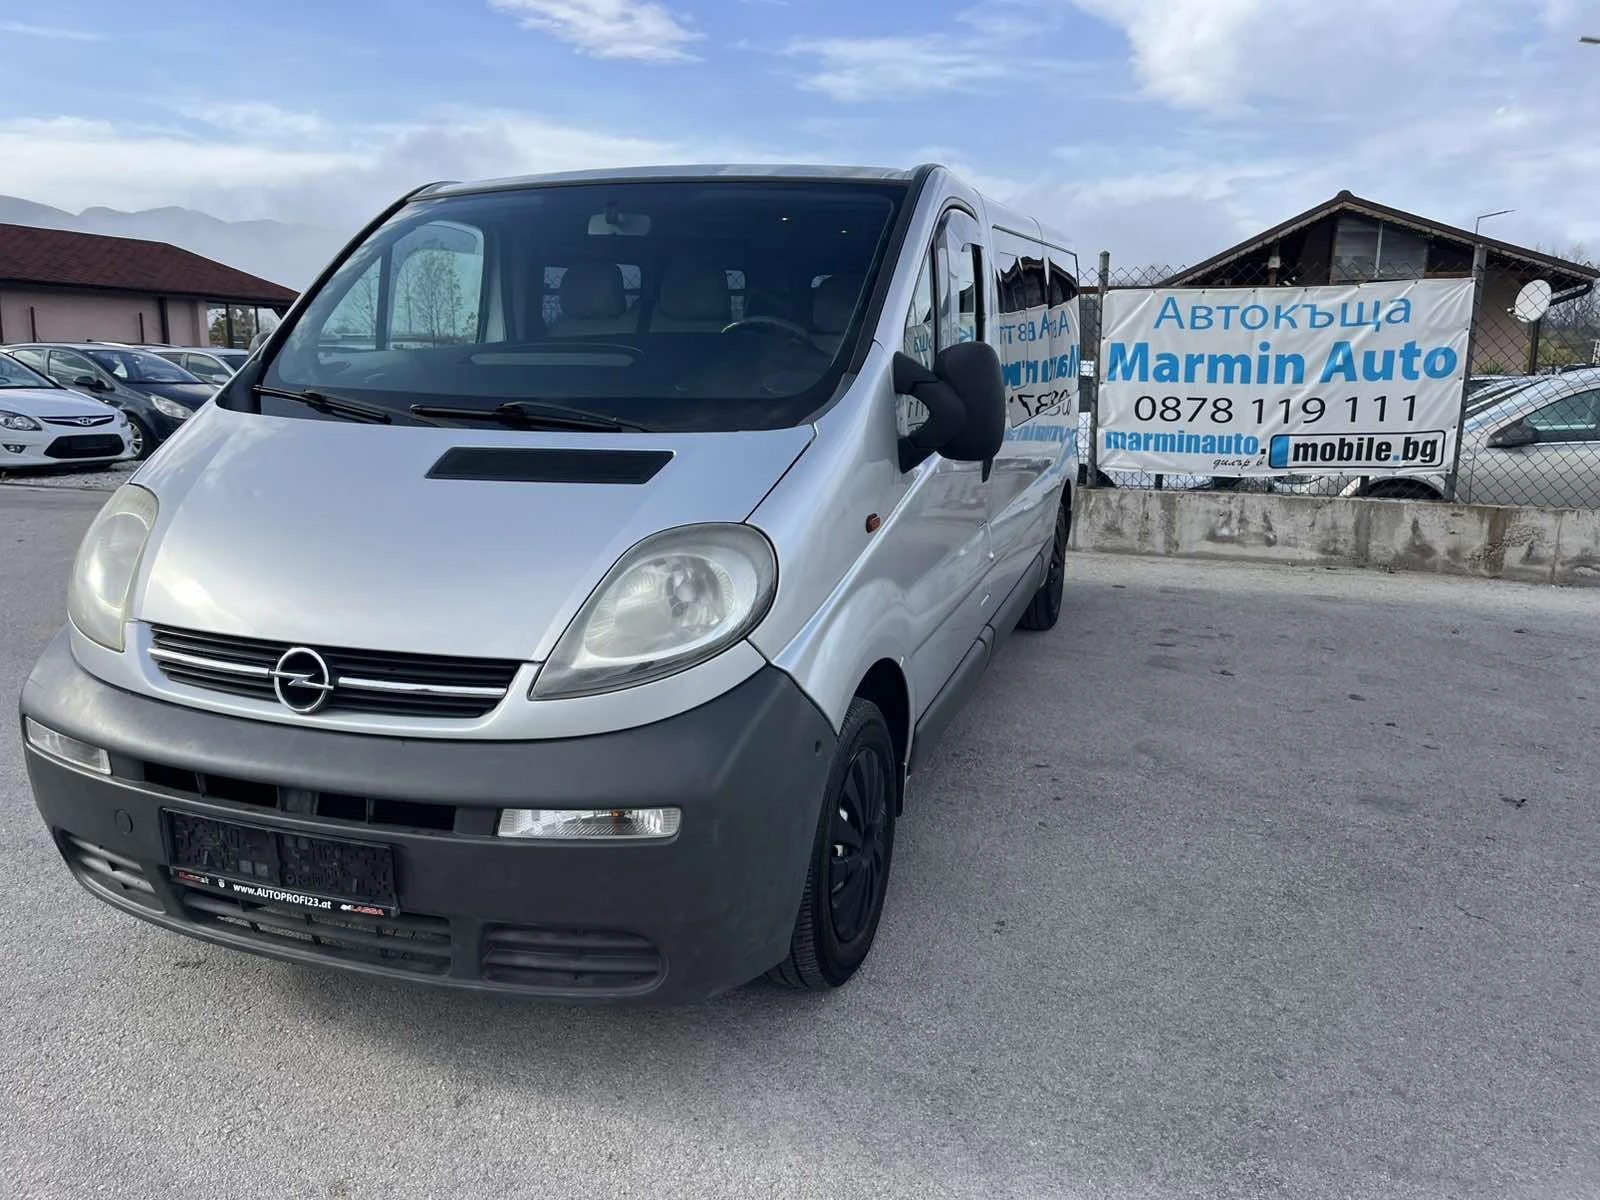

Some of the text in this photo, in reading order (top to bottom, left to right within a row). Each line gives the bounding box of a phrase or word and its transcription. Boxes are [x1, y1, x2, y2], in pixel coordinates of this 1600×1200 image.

[1154, 296, 1412, 332] Автокъща
[1108, 341, 1305, 384] Marmin
[1320, 340, 1458, 382] Auto
[1134, 395, 1417, 424] 0878 119 111
[1292, 437, 1438, 464] mobile.bg
[233, 884, 332, 909] www.AUTOPROFI23.at
